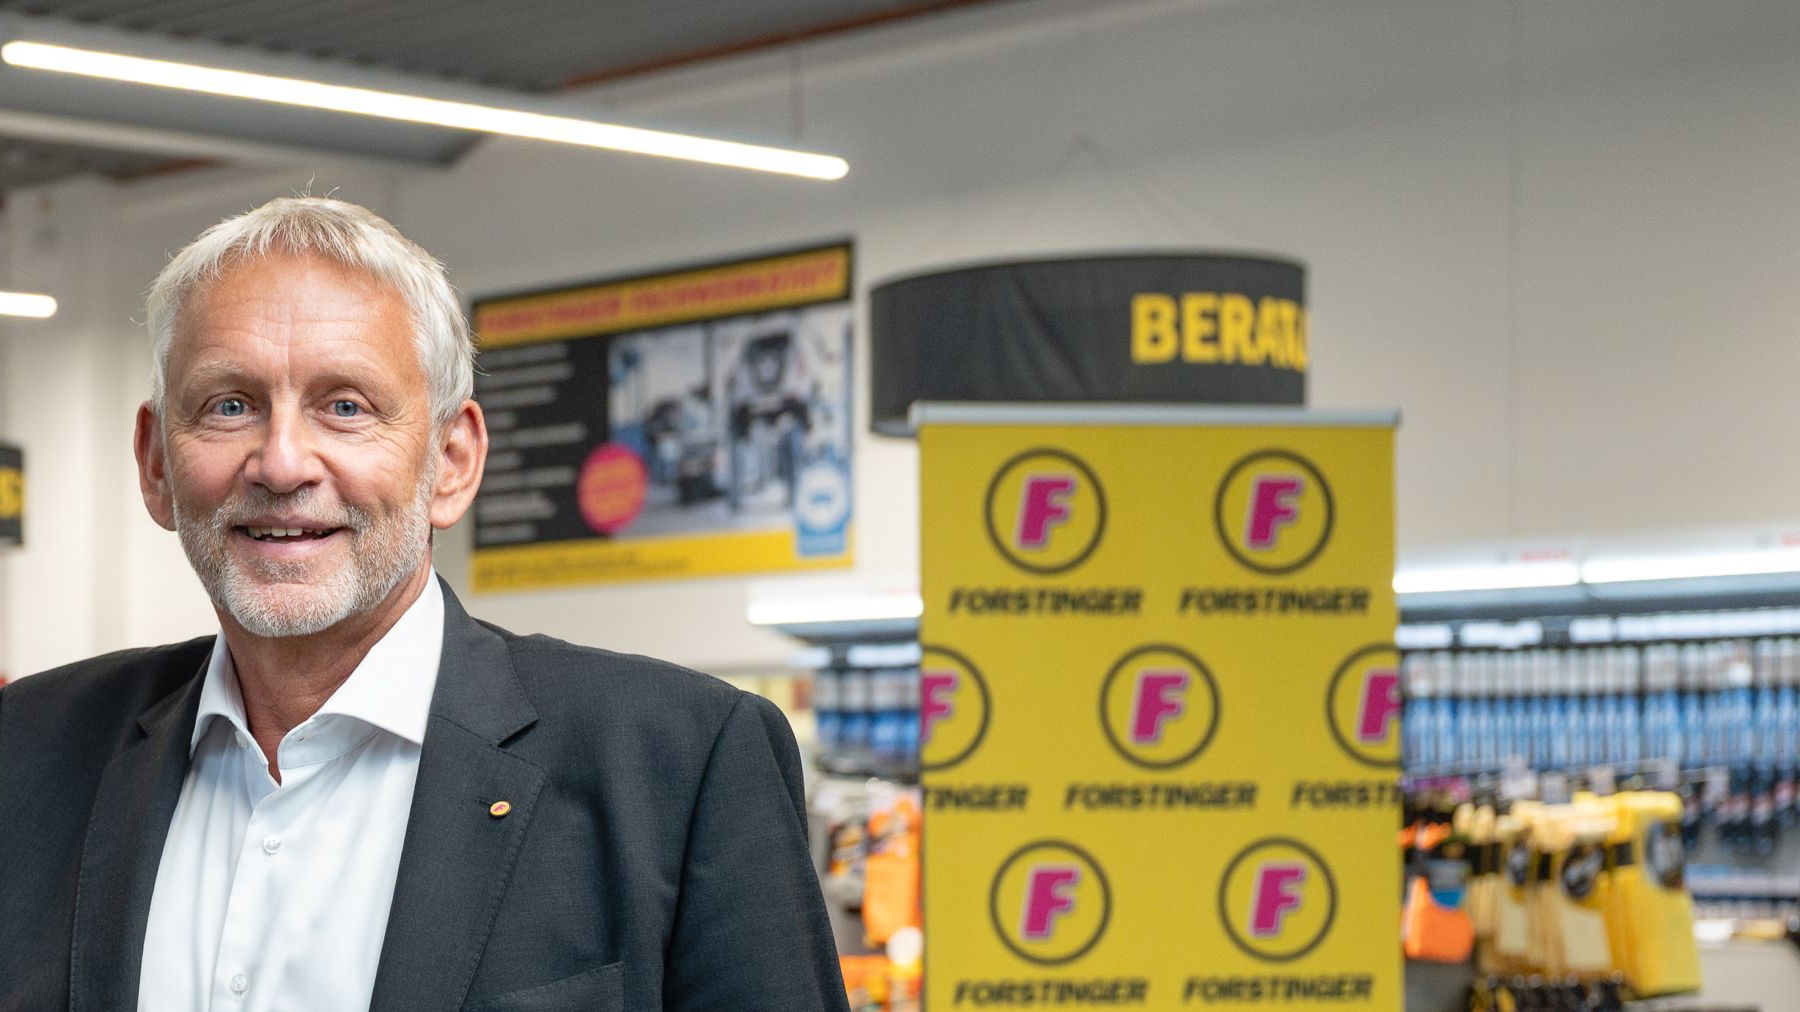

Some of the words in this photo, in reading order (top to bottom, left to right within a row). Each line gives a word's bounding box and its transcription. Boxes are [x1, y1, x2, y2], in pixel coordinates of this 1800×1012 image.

[1015, 472, 1076, 549] F
[1245, 473, 1304, 550] F
[949, 587, 1143, 617] FORSTINGER
[1179, 587, 1370, 617] FORSTINGER
[1128, 667, 1189, 745] F
[1064, 782, 1259, 813] FORSTINGER
[1019, 861, 1081, 941] F
[1247, 860, 1307, 938] F
[952, 978, 1148, 1008] FORSTINGER
[1183, 973, 1374, 1003] FORSTINGER
